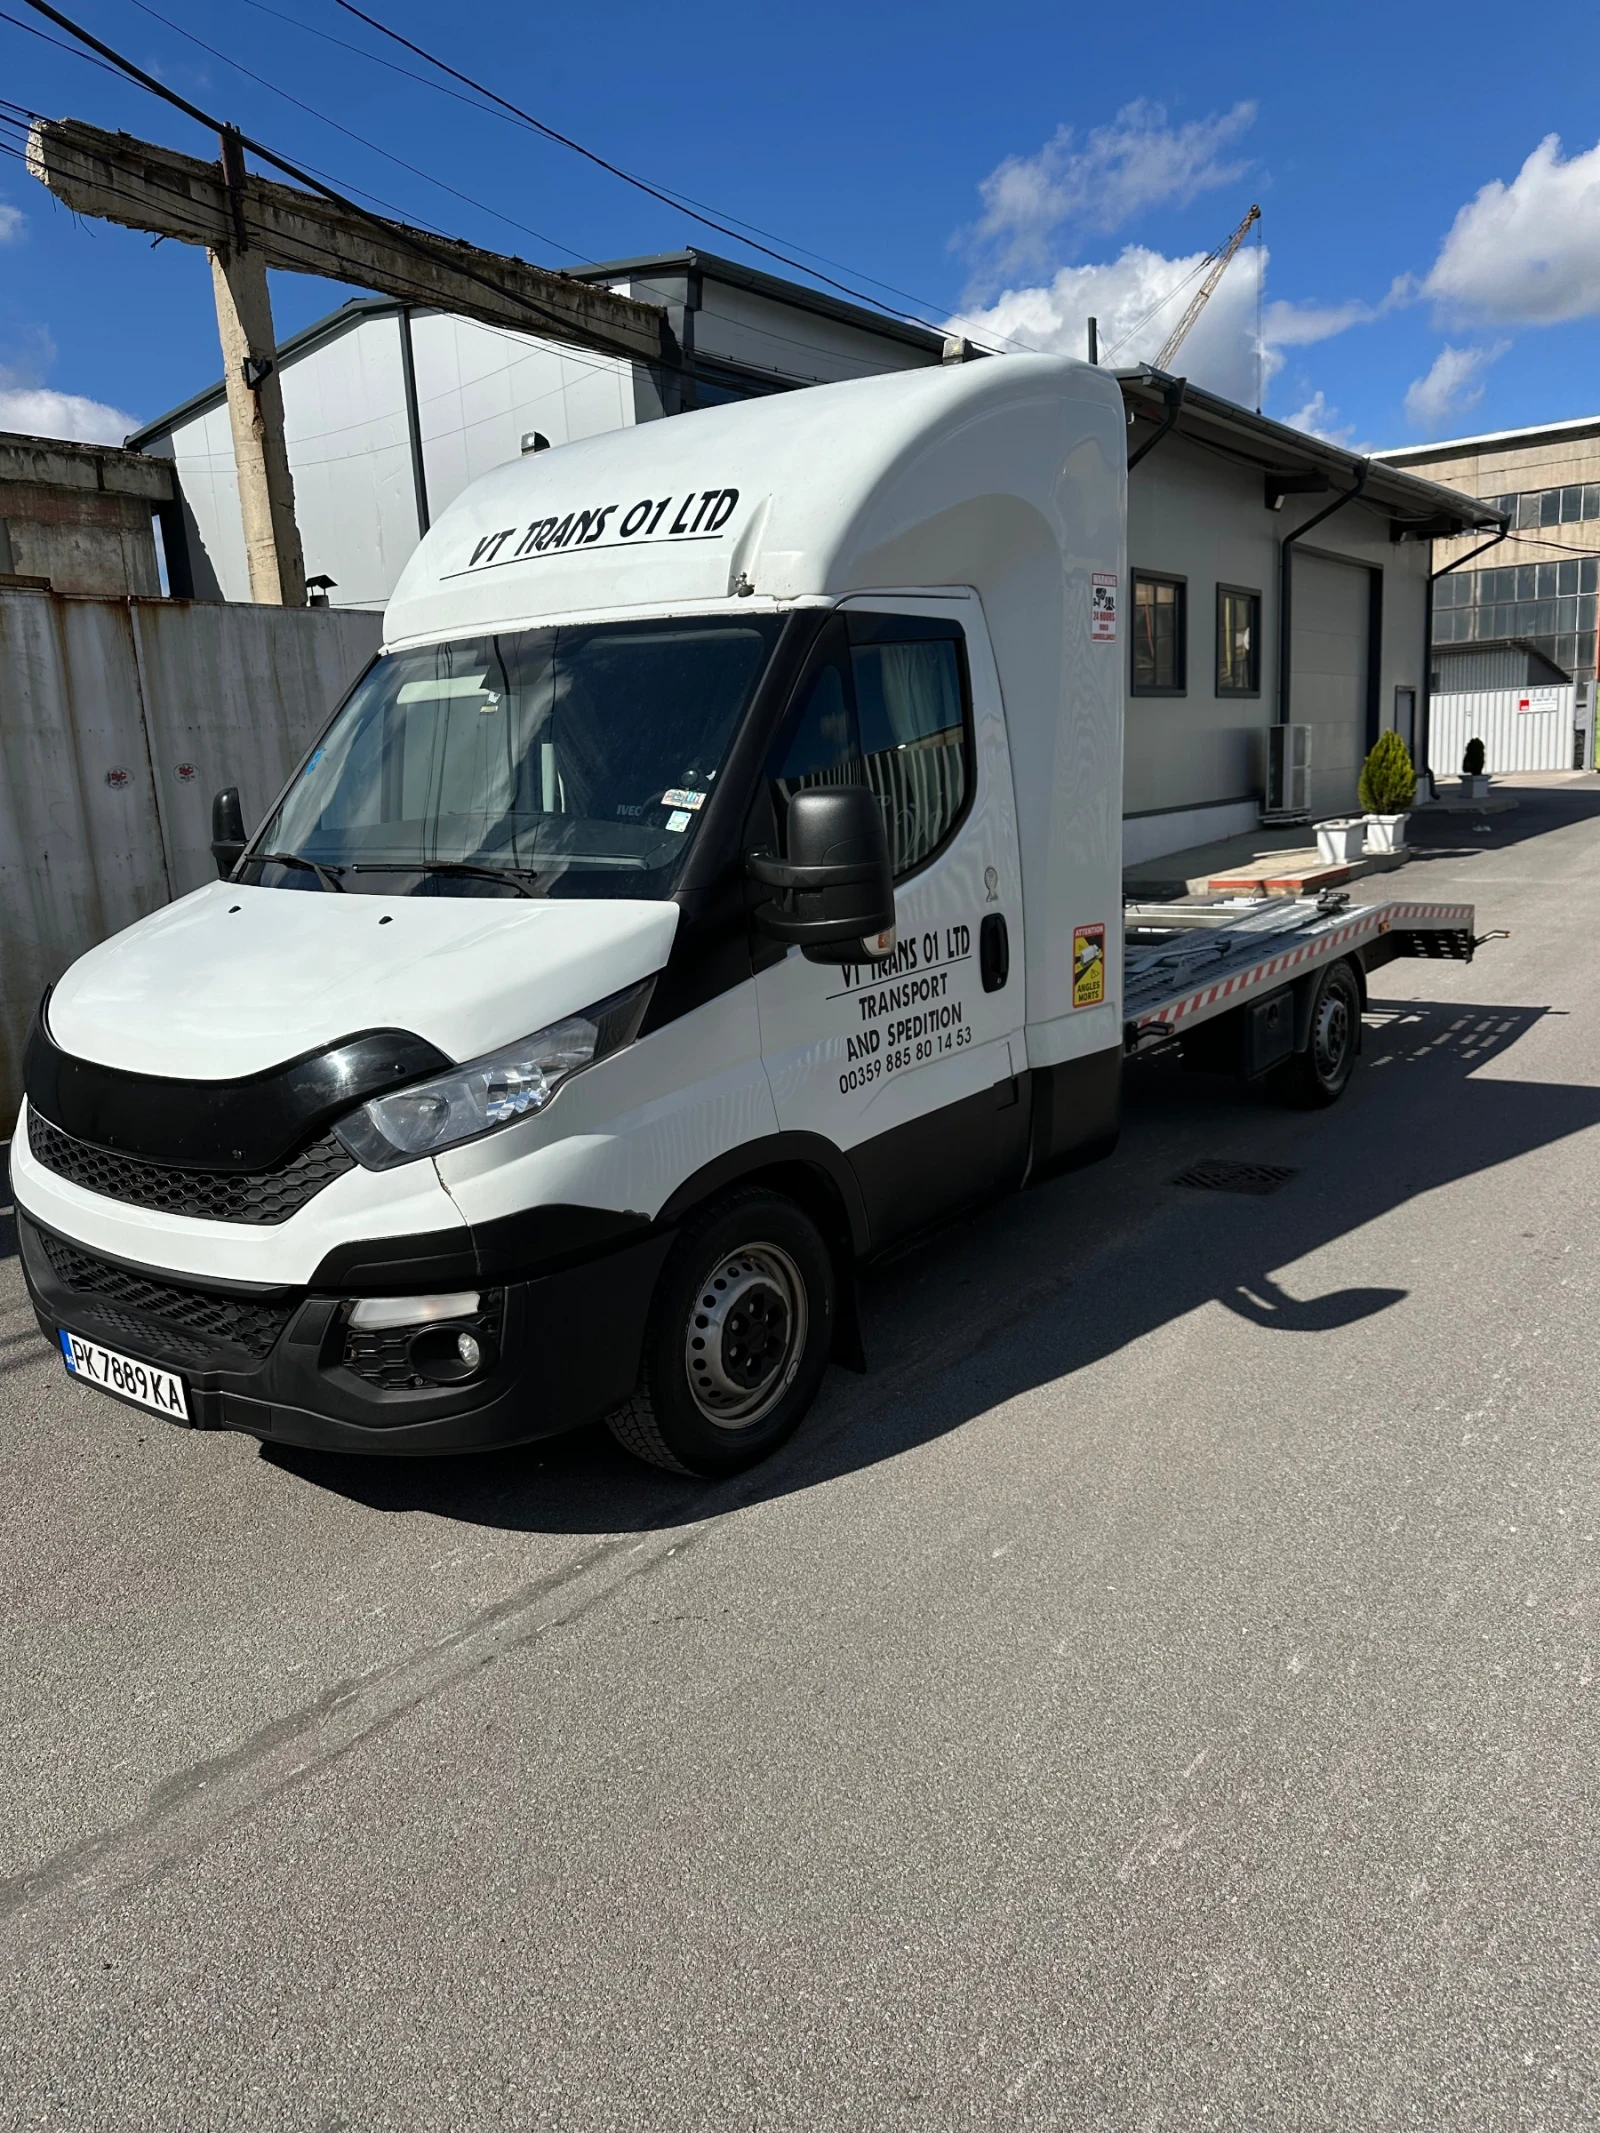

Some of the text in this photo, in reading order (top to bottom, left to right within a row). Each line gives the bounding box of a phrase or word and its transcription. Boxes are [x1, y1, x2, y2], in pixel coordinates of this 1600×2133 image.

[469, 488, 740, 566] VT TRANS 01 LTD
[1093, 611, 1115, 622] 24 HOURS
[616, 804, 643, 817] IVEC
[1075, 925, 1103, 936] ATTENTION
[923, 931, 939, 963] 01
[946, 925, 971, 959] LTD
[858, 973, 948, 1020] TRANSPORT
[1077, 981, 1100, 993] ANGLES
[1078, 990, 1099, 1002] MORTS
[846, 1001, 962, 1062] AND SPEDITION
[839, 1026, 972, 1094] 00359 885 80 14 53
